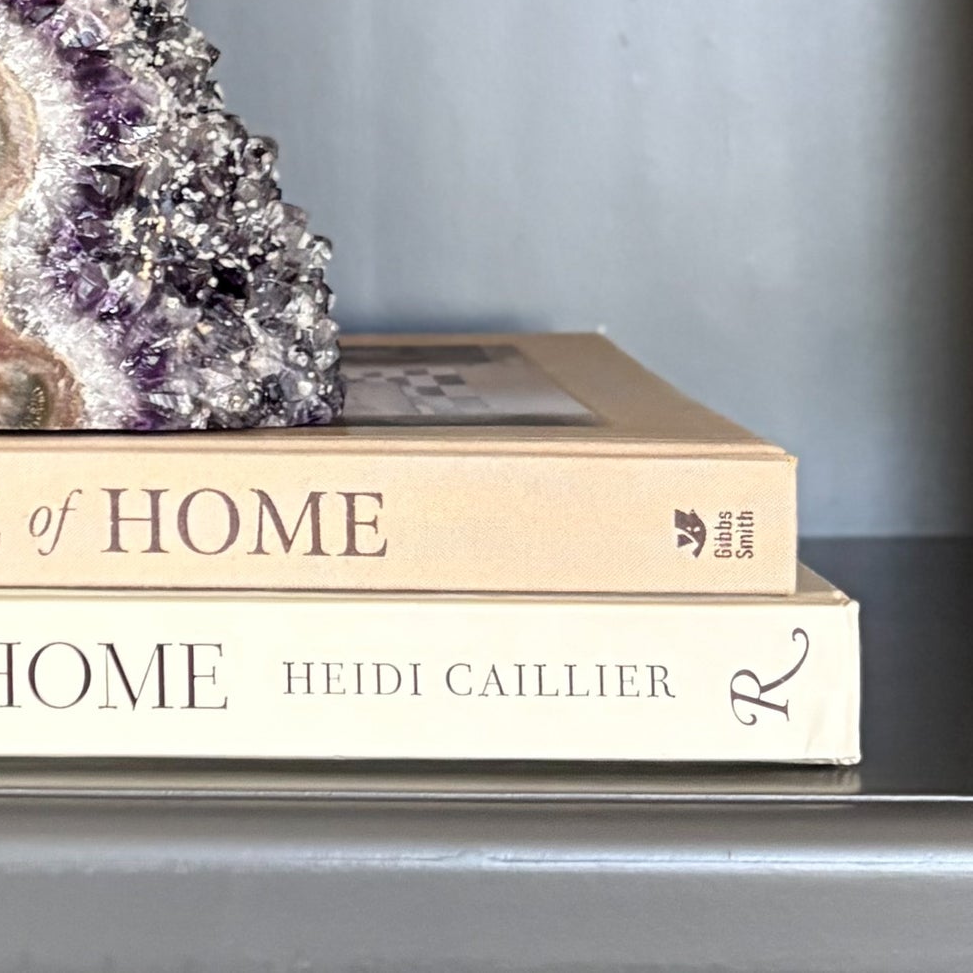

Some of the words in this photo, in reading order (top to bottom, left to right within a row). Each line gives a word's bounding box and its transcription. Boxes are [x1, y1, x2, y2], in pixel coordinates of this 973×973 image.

[29, 489, 83, 557] of
[100, 488, 388, 558] HOME
[714, 510, 733, 559] Gibbs
[736, 510, 754, 559] Smith
[283, 661, 422, 697] HEIDI
[445, 662, 677, 699] CAILLIER
